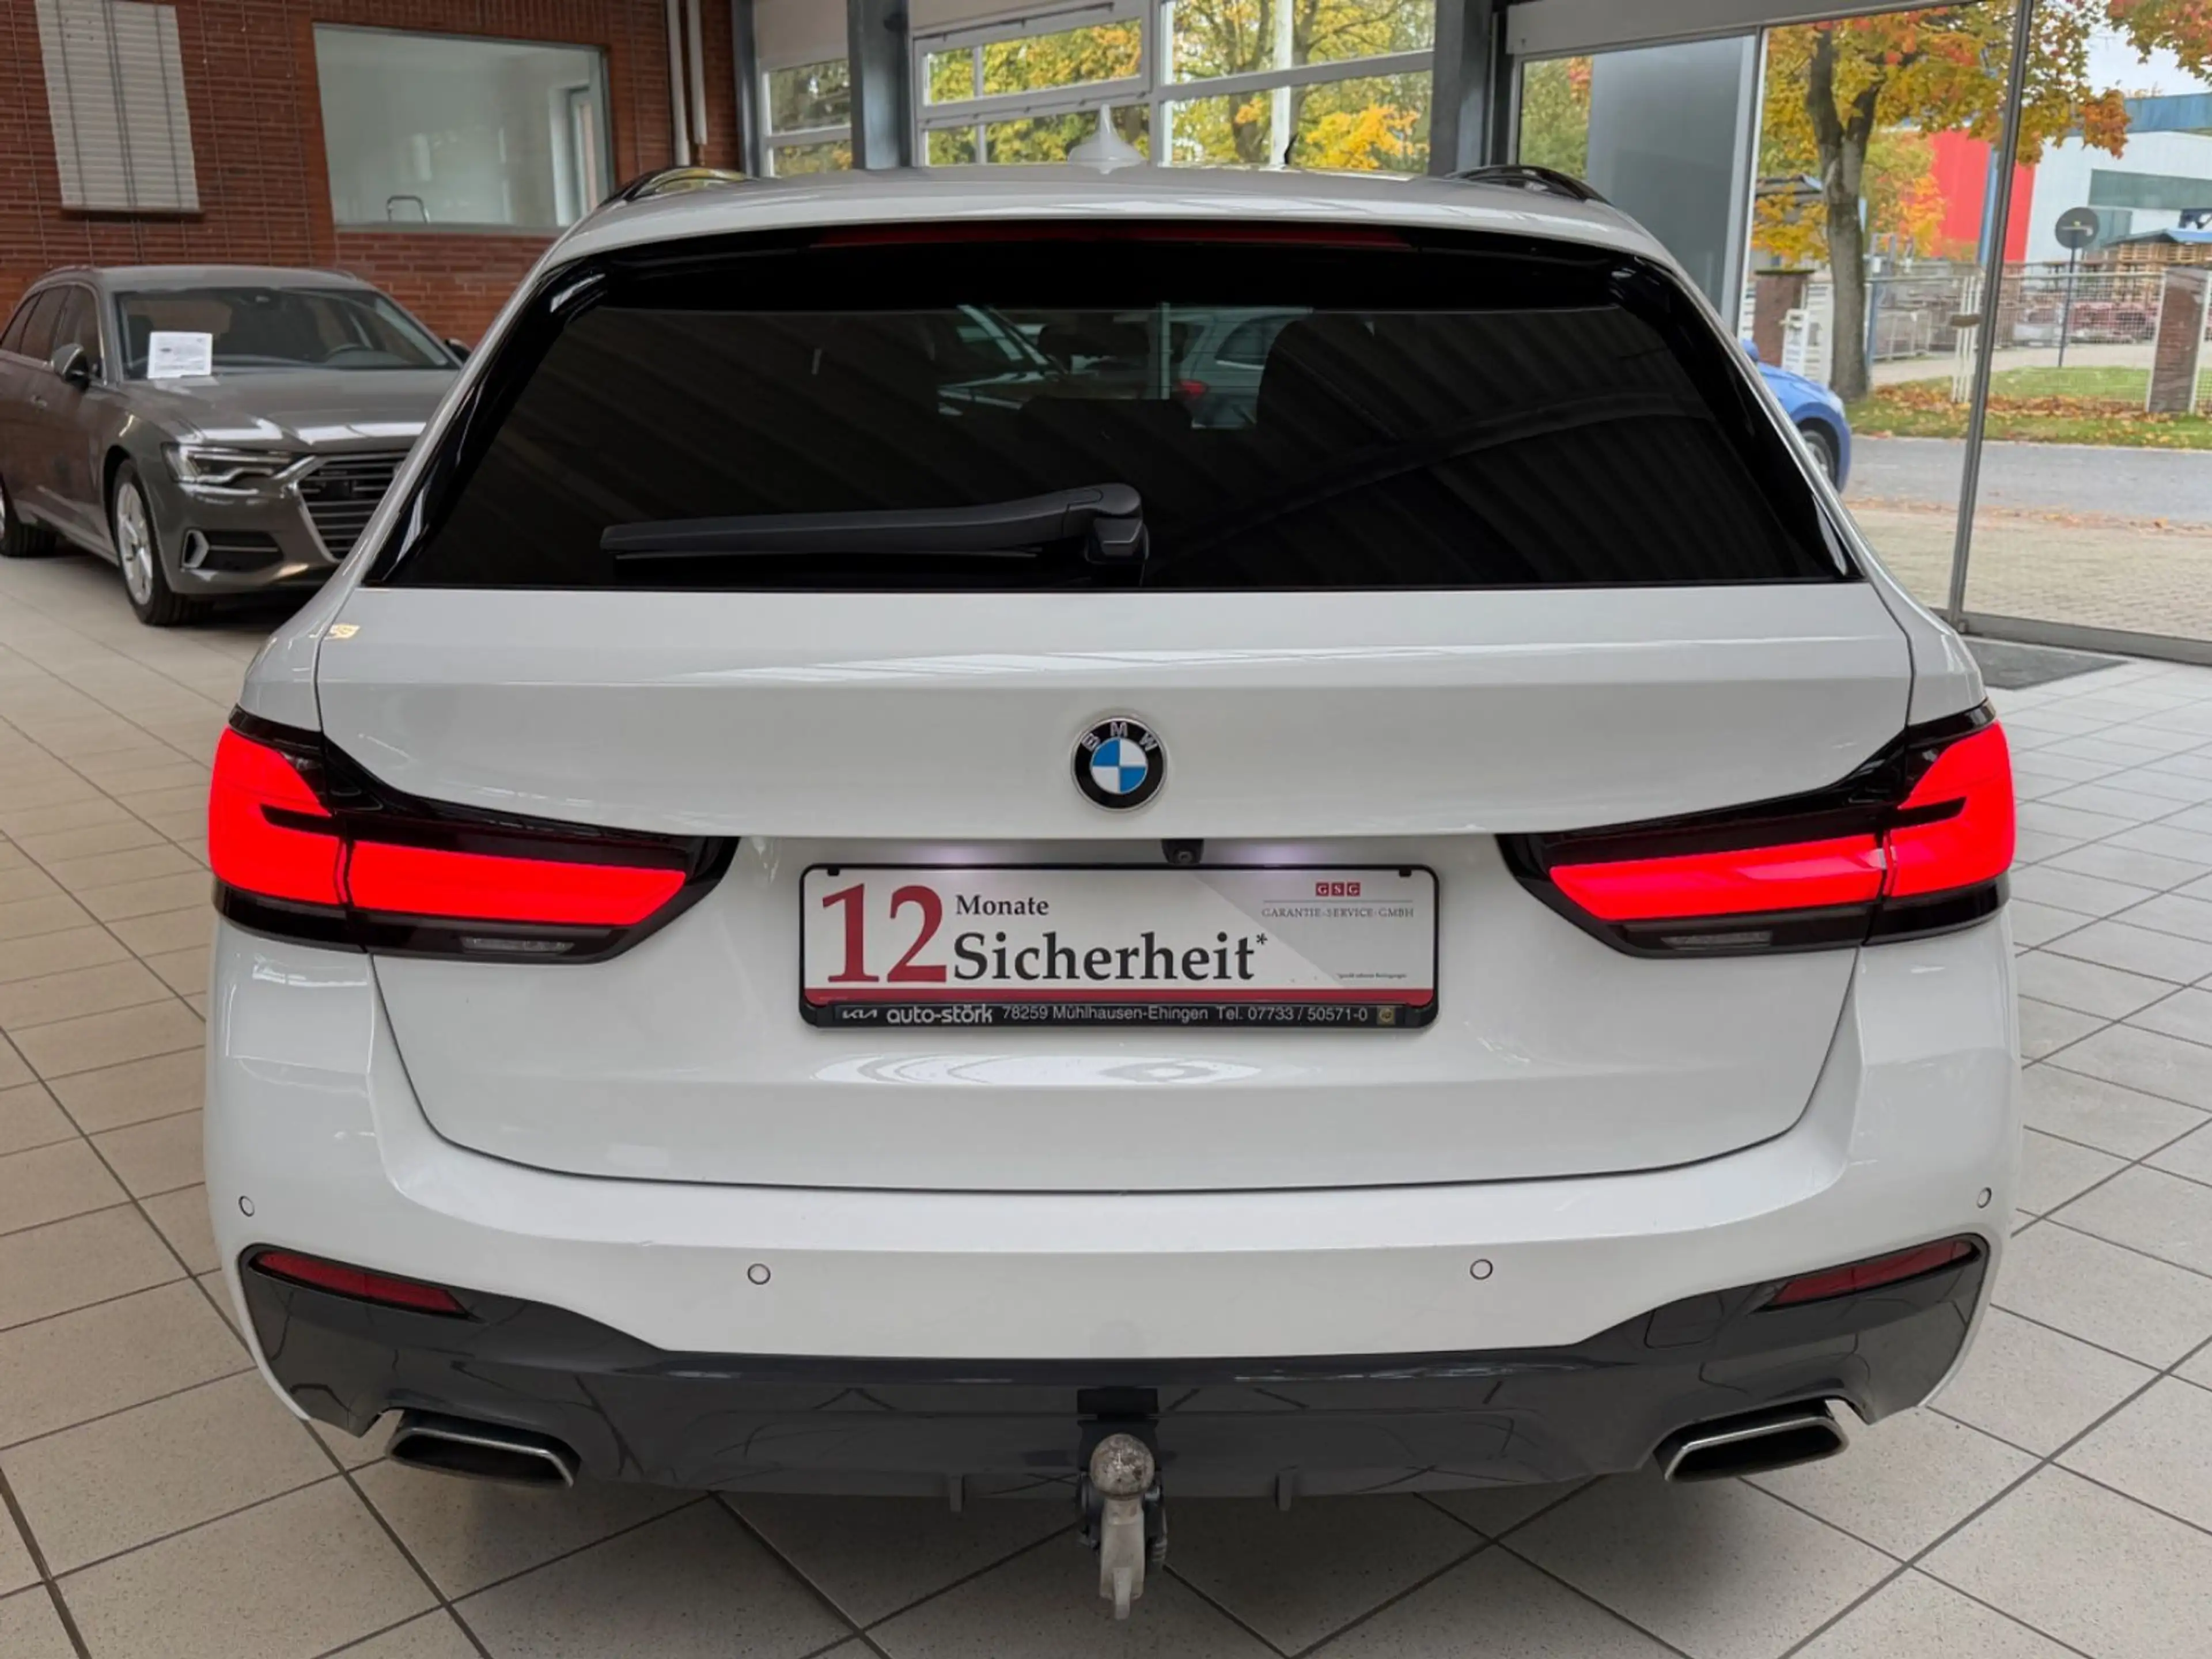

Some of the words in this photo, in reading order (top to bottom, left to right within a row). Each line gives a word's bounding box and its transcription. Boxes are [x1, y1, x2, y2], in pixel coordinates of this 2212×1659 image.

[1080, 721, 1158, 752] BMW
[1316, 883, 1359, 896] GSG
[955, 894, 1050, 915] Monate
[822, 882, 948, 983] 12
[886, 1004, 993, 1024] auto-störk
[1002, 1006, 1048, 1020] 78259
[1053, 1005, 1209, 1024] Mühlhausen-Ehingen
[1217, 1006, 1243, 1020] Tel.
[1247, 1007, 1294, 1020] 07733
[1307, 1007, 1368, 1021] 50571-0
